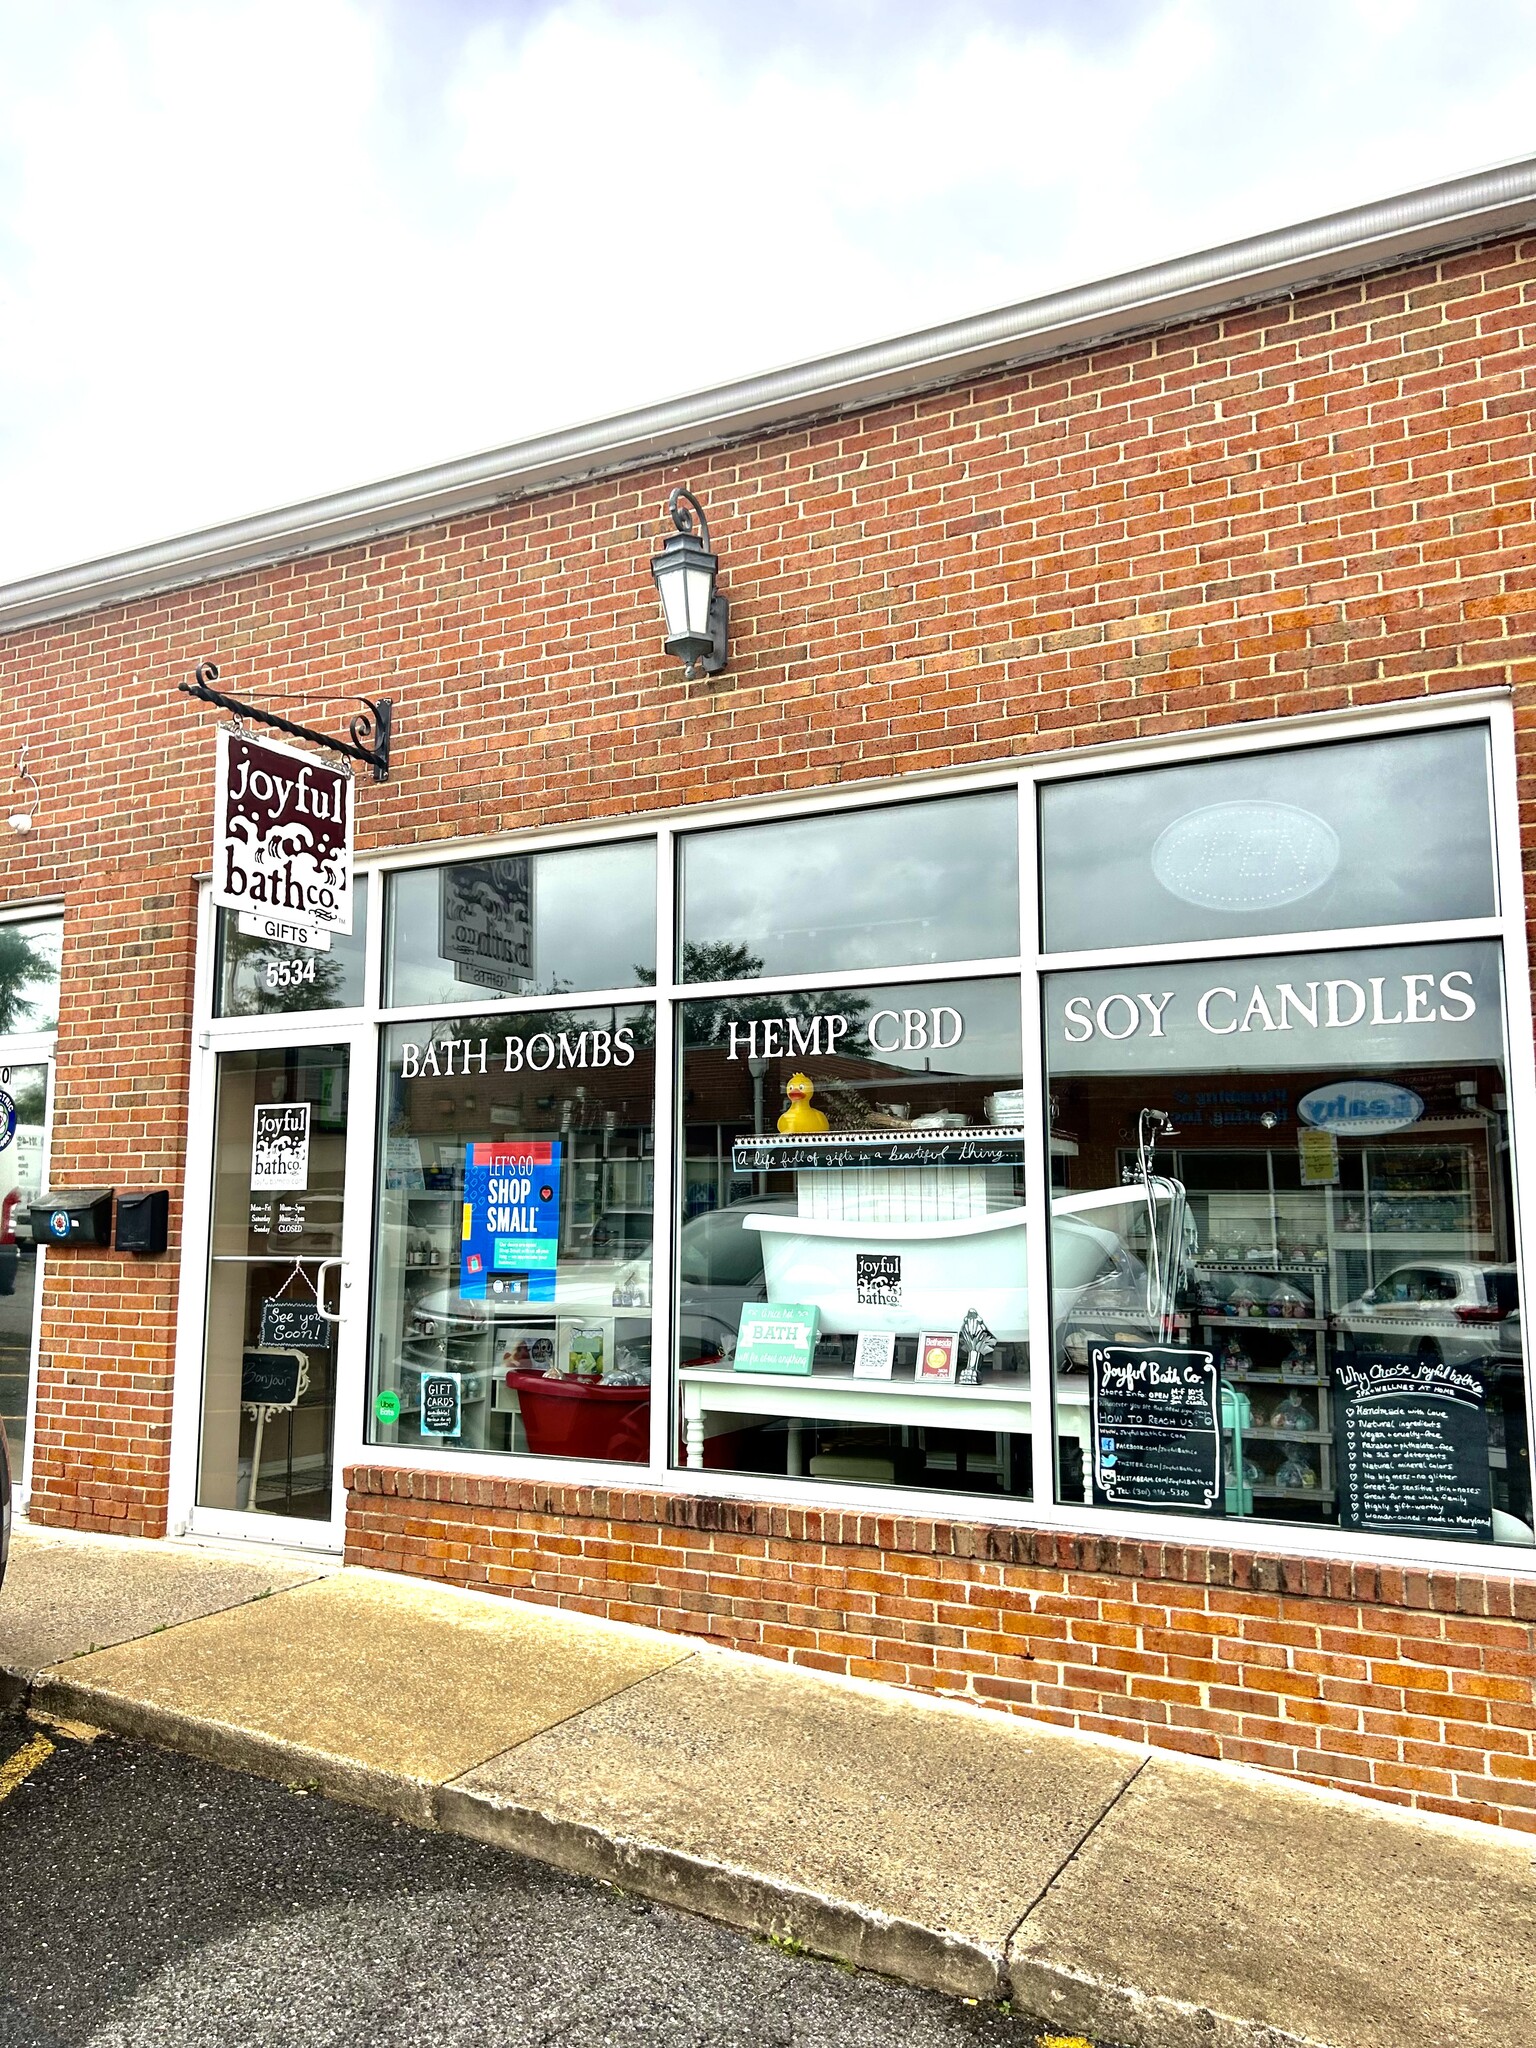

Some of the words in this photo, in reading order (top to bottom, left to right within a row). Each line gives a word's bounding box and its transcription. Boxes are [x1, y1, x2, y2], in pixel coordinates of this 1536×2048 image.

[230, 746, 342, 824] joyful
[1165, 828, 1316, 878] OPEN
[264, 921, 308, 944] GIFTS
[266, 959, 316, 987] 5534
[1064, 992, 1175, 1042] SOY
[1197, 970, 1477, 1035] CANDLES
[726, 1014, 848, 1061] HEMP
[868, 1006, 964, 1052] CBD
[400, 1038, 488, 1078] BATH
[504, 1028, 634, 1073] BOMBS
[258, 1109, 304, 1138] joyful
[754, 1151, 776, 1170] life
[780, 1150, 804, 1168] full
[806, 1152, 819, 1166] of
[826, 1149, 854, 1166] gifts
[859, 1151, 870, 1161] is
[888, 1145, 950, 1164] beautiful
[489, 1156, 516, 1176] LET'S
[518, 1155, 534, 1176] GO
[488, 1178, 530, 1204] SHOP
[252, 1214, 270, 1224] Saturday
[486, 1206, 538, 1232] SMALL
[254, 1224, 270, 1234] Sunday
[278, 1224, 302, 1232] CLOSED
[858, 1256, 900, 1277] joyful
[268, 1308, 294, 1324] See
[300, 1313, 324, 1330] you
[274, 1324, 320, 1340] Soon!
[752, 1326, 798, 1340] BATH
[244, 1362, 291, 1390] Bonjour
[1102, 1361, 1148, 1391] Joyful
[1148, 1362, 1182, 1384] Bath
[1184, 1366, 1204, 1384] Co.
[1336, 1365, 1370, 1391] Why
[1370, 1364, 1411, 1379] Choose
[1411, 1362, 1450, 1381] joyful
[428, 1384, 452, 1395] GIFT
[1100, 1388, 1124, 1396] Store
[1148, 1392, 1170, 1400] OPEN
[1434, 1386, 1455, 1396] HOME
[380, 1400, 394, 1408] Uber
[426, 1397, 454, 1407] CARDS
[1130, 1402, 1141, 1410] you
[380, 1408, 394, 1416] Eats
[1356, 1405, 1405, 1415] Handmade
[1407, 1406, 1424, 1415] with
[1099, 1412, 1123, 1423] HOW
[1128, 1414, 1143, 1423] TO
[1148, 1414, 1176, 1425] REACH
[1358, 1420, 1395, 1428] Natural
[1398, 1420, 1442, 1430] ingredients
[1360, 1430, 1386, 1442] Vegan
[1362, 1442, 1392, 1450] Paraben
[1404, 1451, 1446, 1460] detergents
[1362, 1462, 1394, 1470] Natural
[1428, 1462, 1453, 1470] colors
[1378, 1473, 1390, 1482] big
[1428, 1474, 1458, 1482] glitter
[1132, 1488, 1150, 1497] (301)
[1402, 1484, 1432, 1492] sensitive
[1418, 1494, 1439, 1502] whole
[1441, 1495, 1467, 1506] family
[1364, 1502, 1390, 1512] Highly
[1394, 1503, 1444, 1514] gift-worthy
[1456, 1517, 1491, 1527] Maryland
